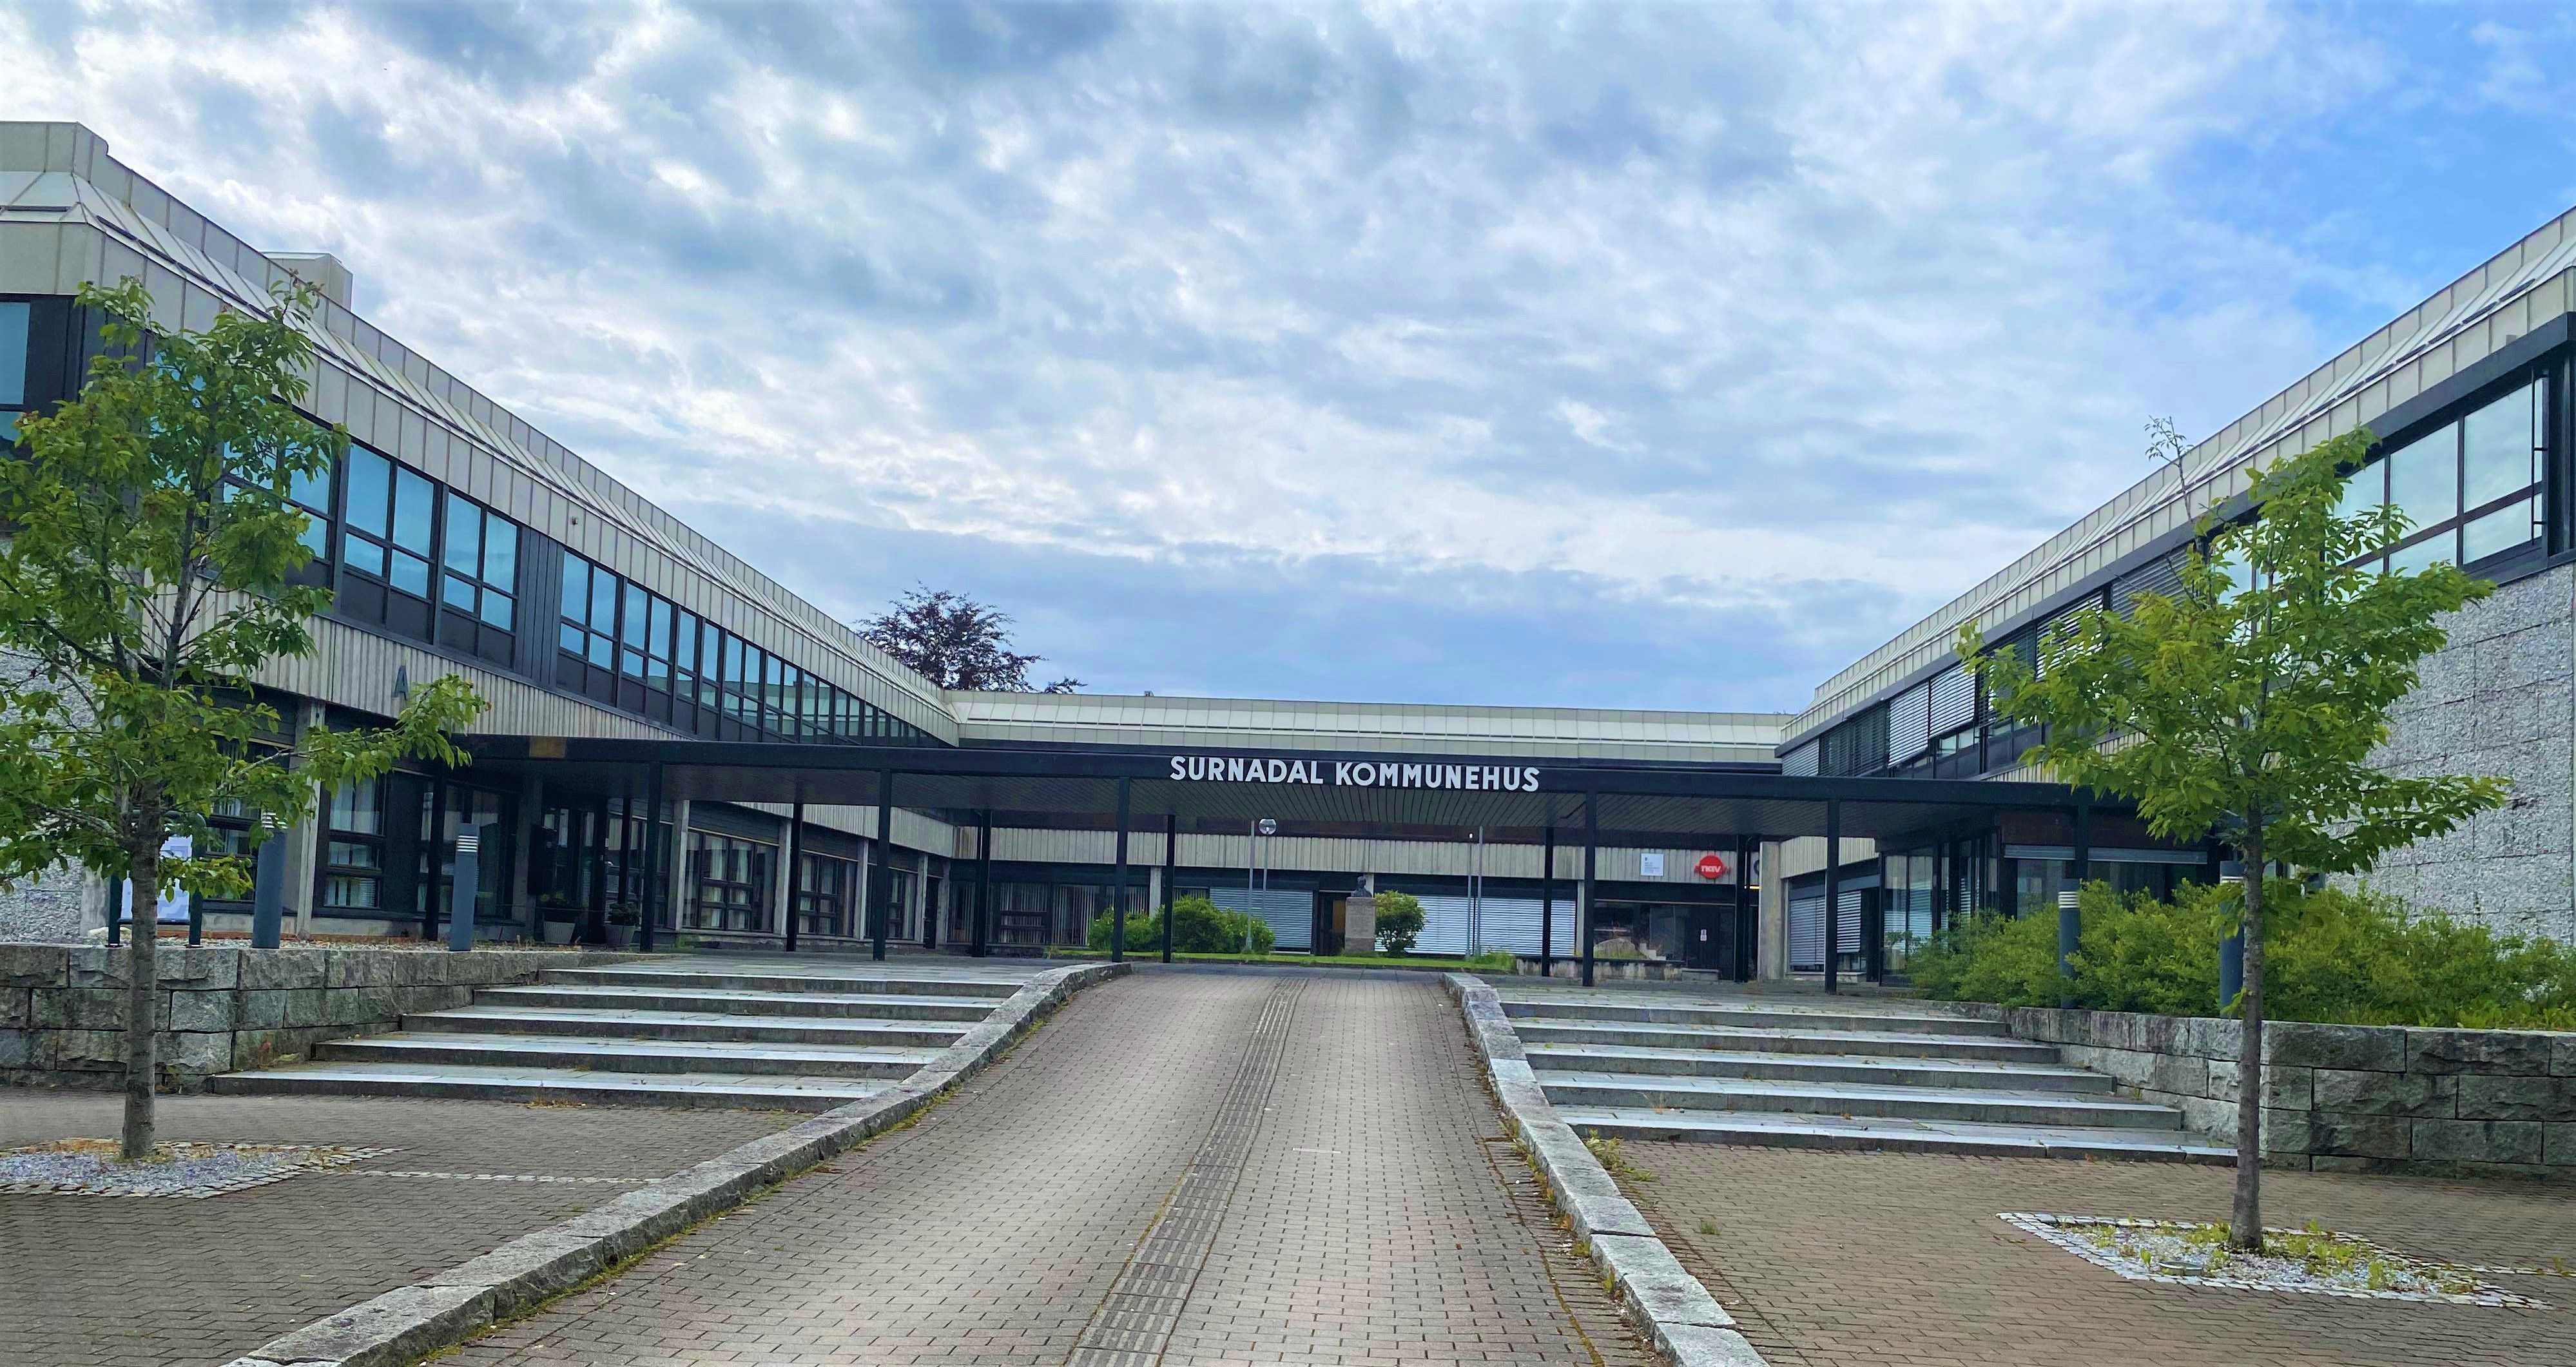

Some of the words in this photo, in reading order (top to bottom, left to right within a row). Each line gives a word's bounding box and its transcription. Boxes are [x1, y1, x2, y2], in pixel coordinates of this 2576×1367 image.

[391, 665, 409, 701] A
[1169, 755, 1324, 784] SURNADAL
[1335, 761, 1540, 792] KOMMUNEHUS
